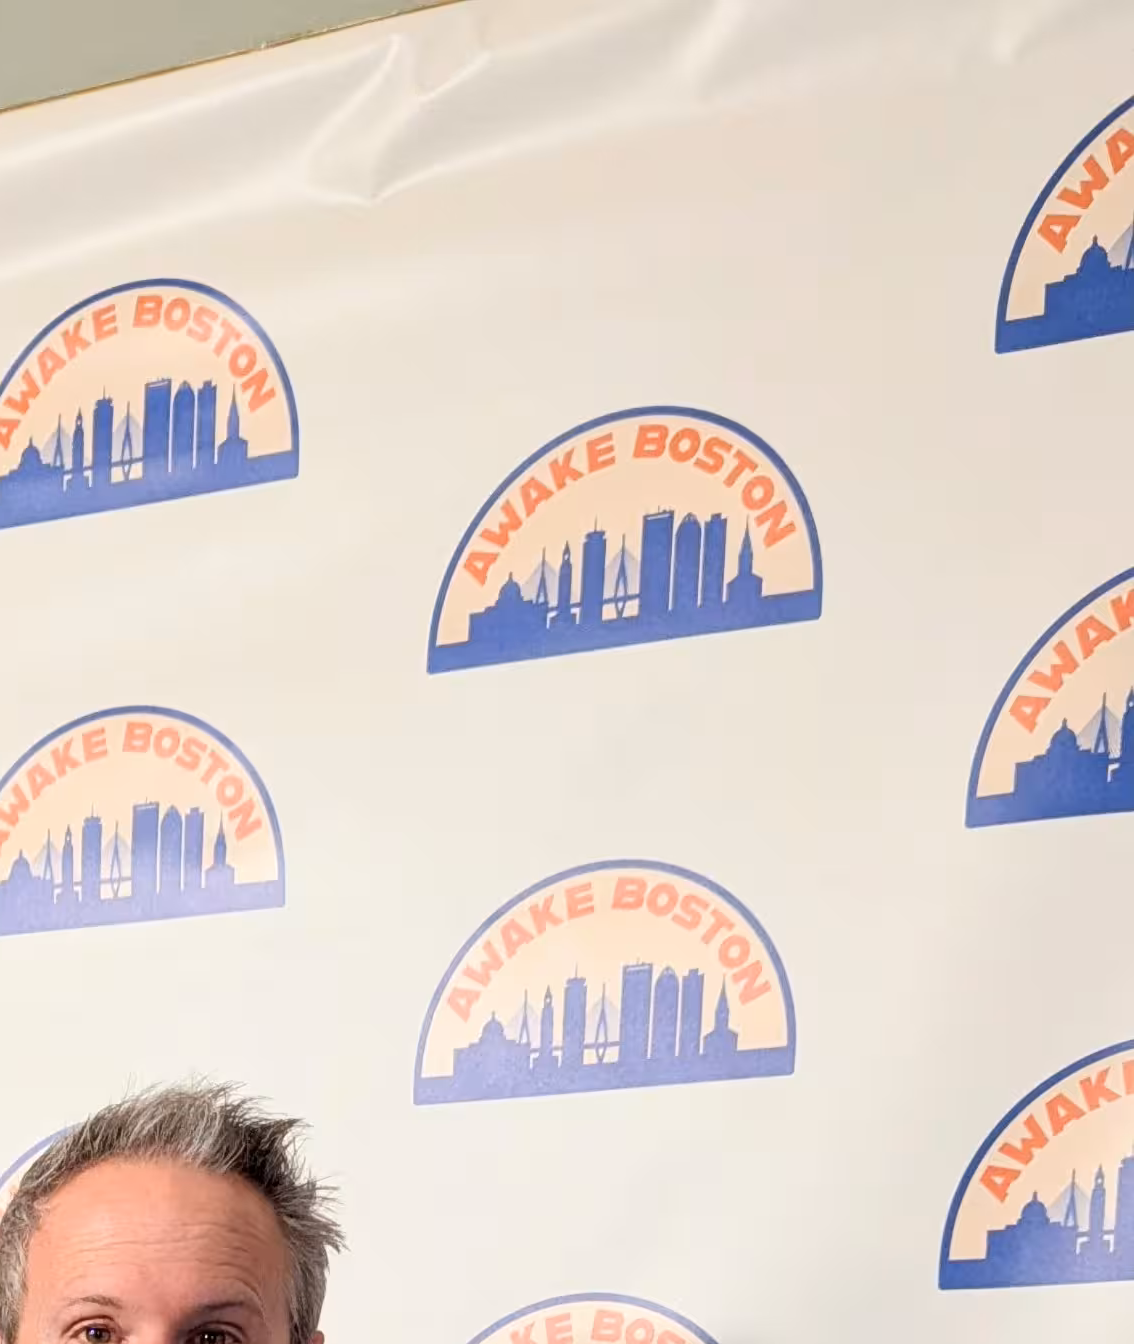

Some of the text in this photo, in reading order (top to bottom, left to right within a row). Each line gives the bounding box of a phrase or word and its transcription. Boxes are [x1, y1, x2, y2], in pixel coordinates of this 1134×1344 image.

[1037, 128, 1134, 254] AWA
[132, 295, 276, 413] BOSTON
[463, 424, 797, 587] AWAKE BOSTON
[1009, 589, 1134, 734] AWAK
[123, 722, 262, 840] BOSTON
[449, 878, 771, 1019] AWAKE BOSTON
